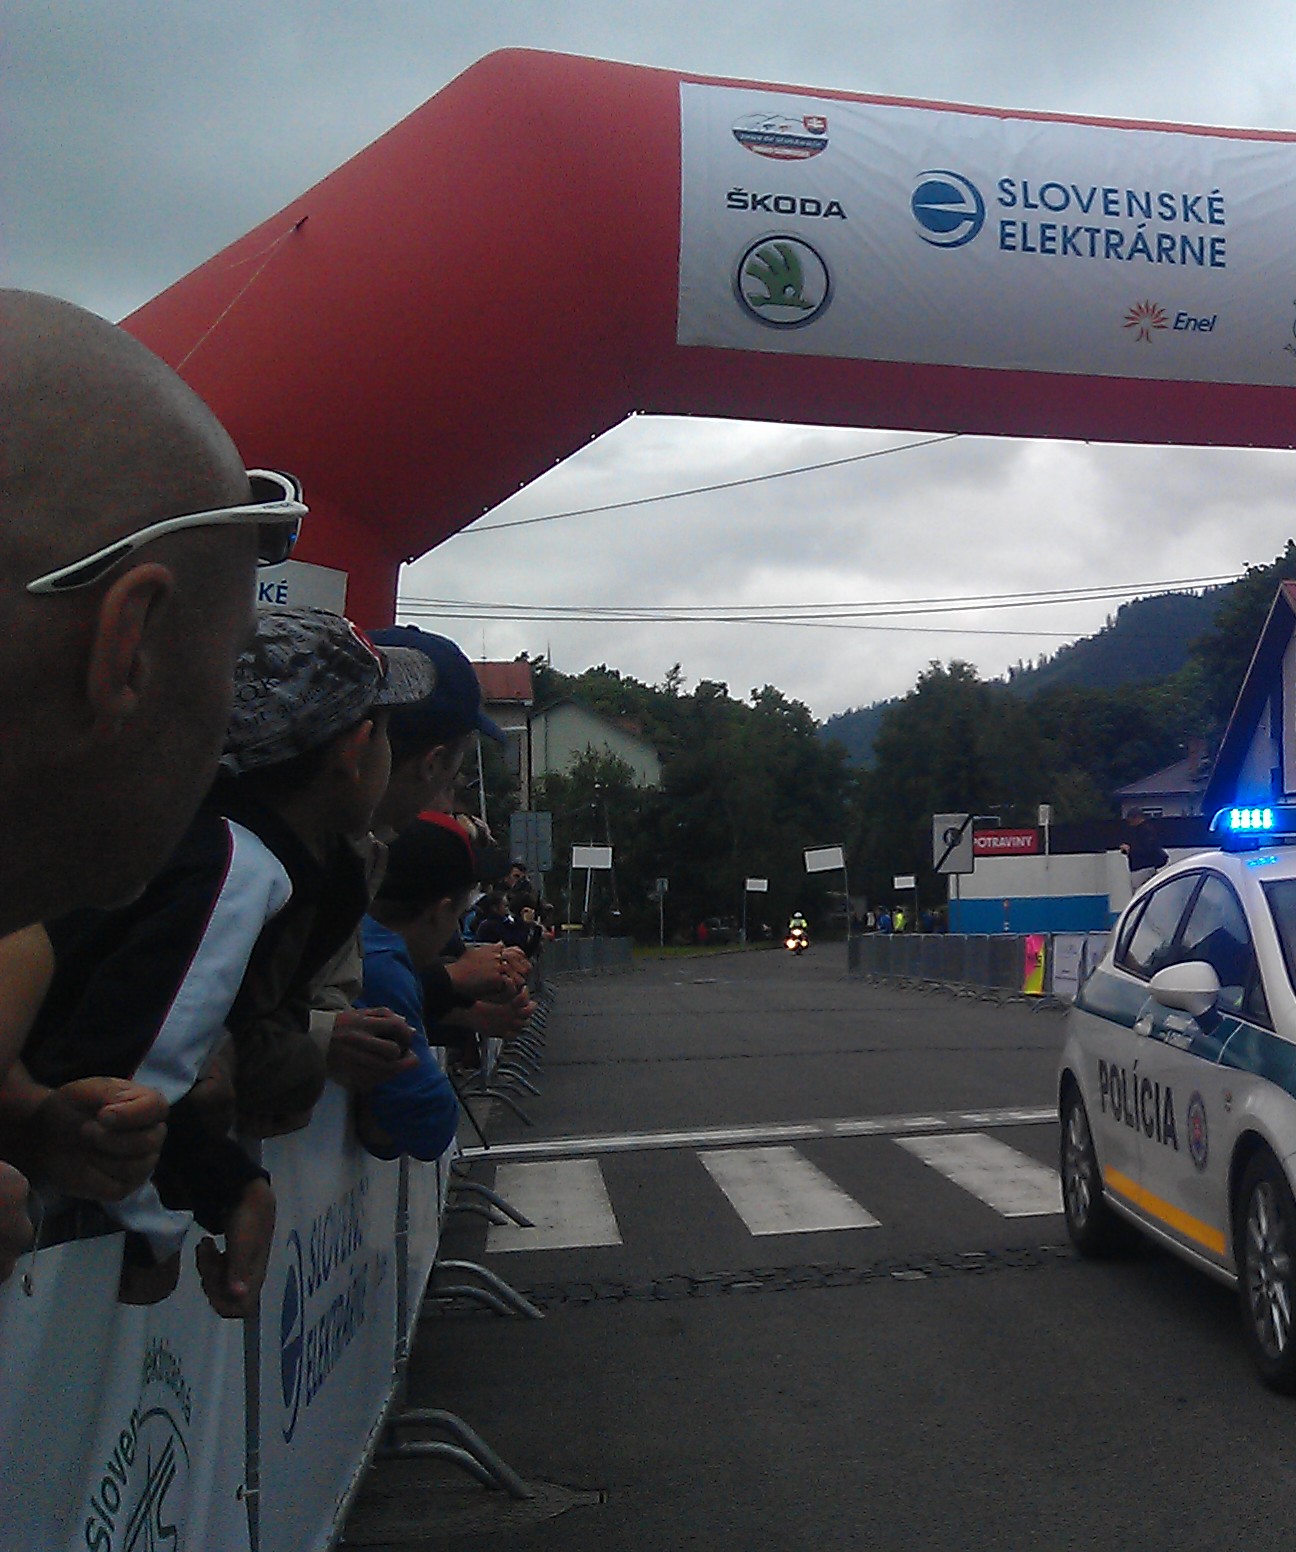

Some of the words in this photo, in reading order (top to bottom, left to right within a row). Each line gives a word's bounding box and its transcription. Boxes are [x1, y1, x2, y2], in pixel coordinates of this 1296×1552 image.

[726, 186, 848, 220] ŠKODA
[997, 176, 1226, 226] SLOVENSKÉ
[999, 219, 1227, 268] ELEKTRÁRNE
[1172, 311, 1218, 333] Enel
[258, 580, 288, 604] KÉ
[1099, 1059, 1179, 1151] POLÍCIA
